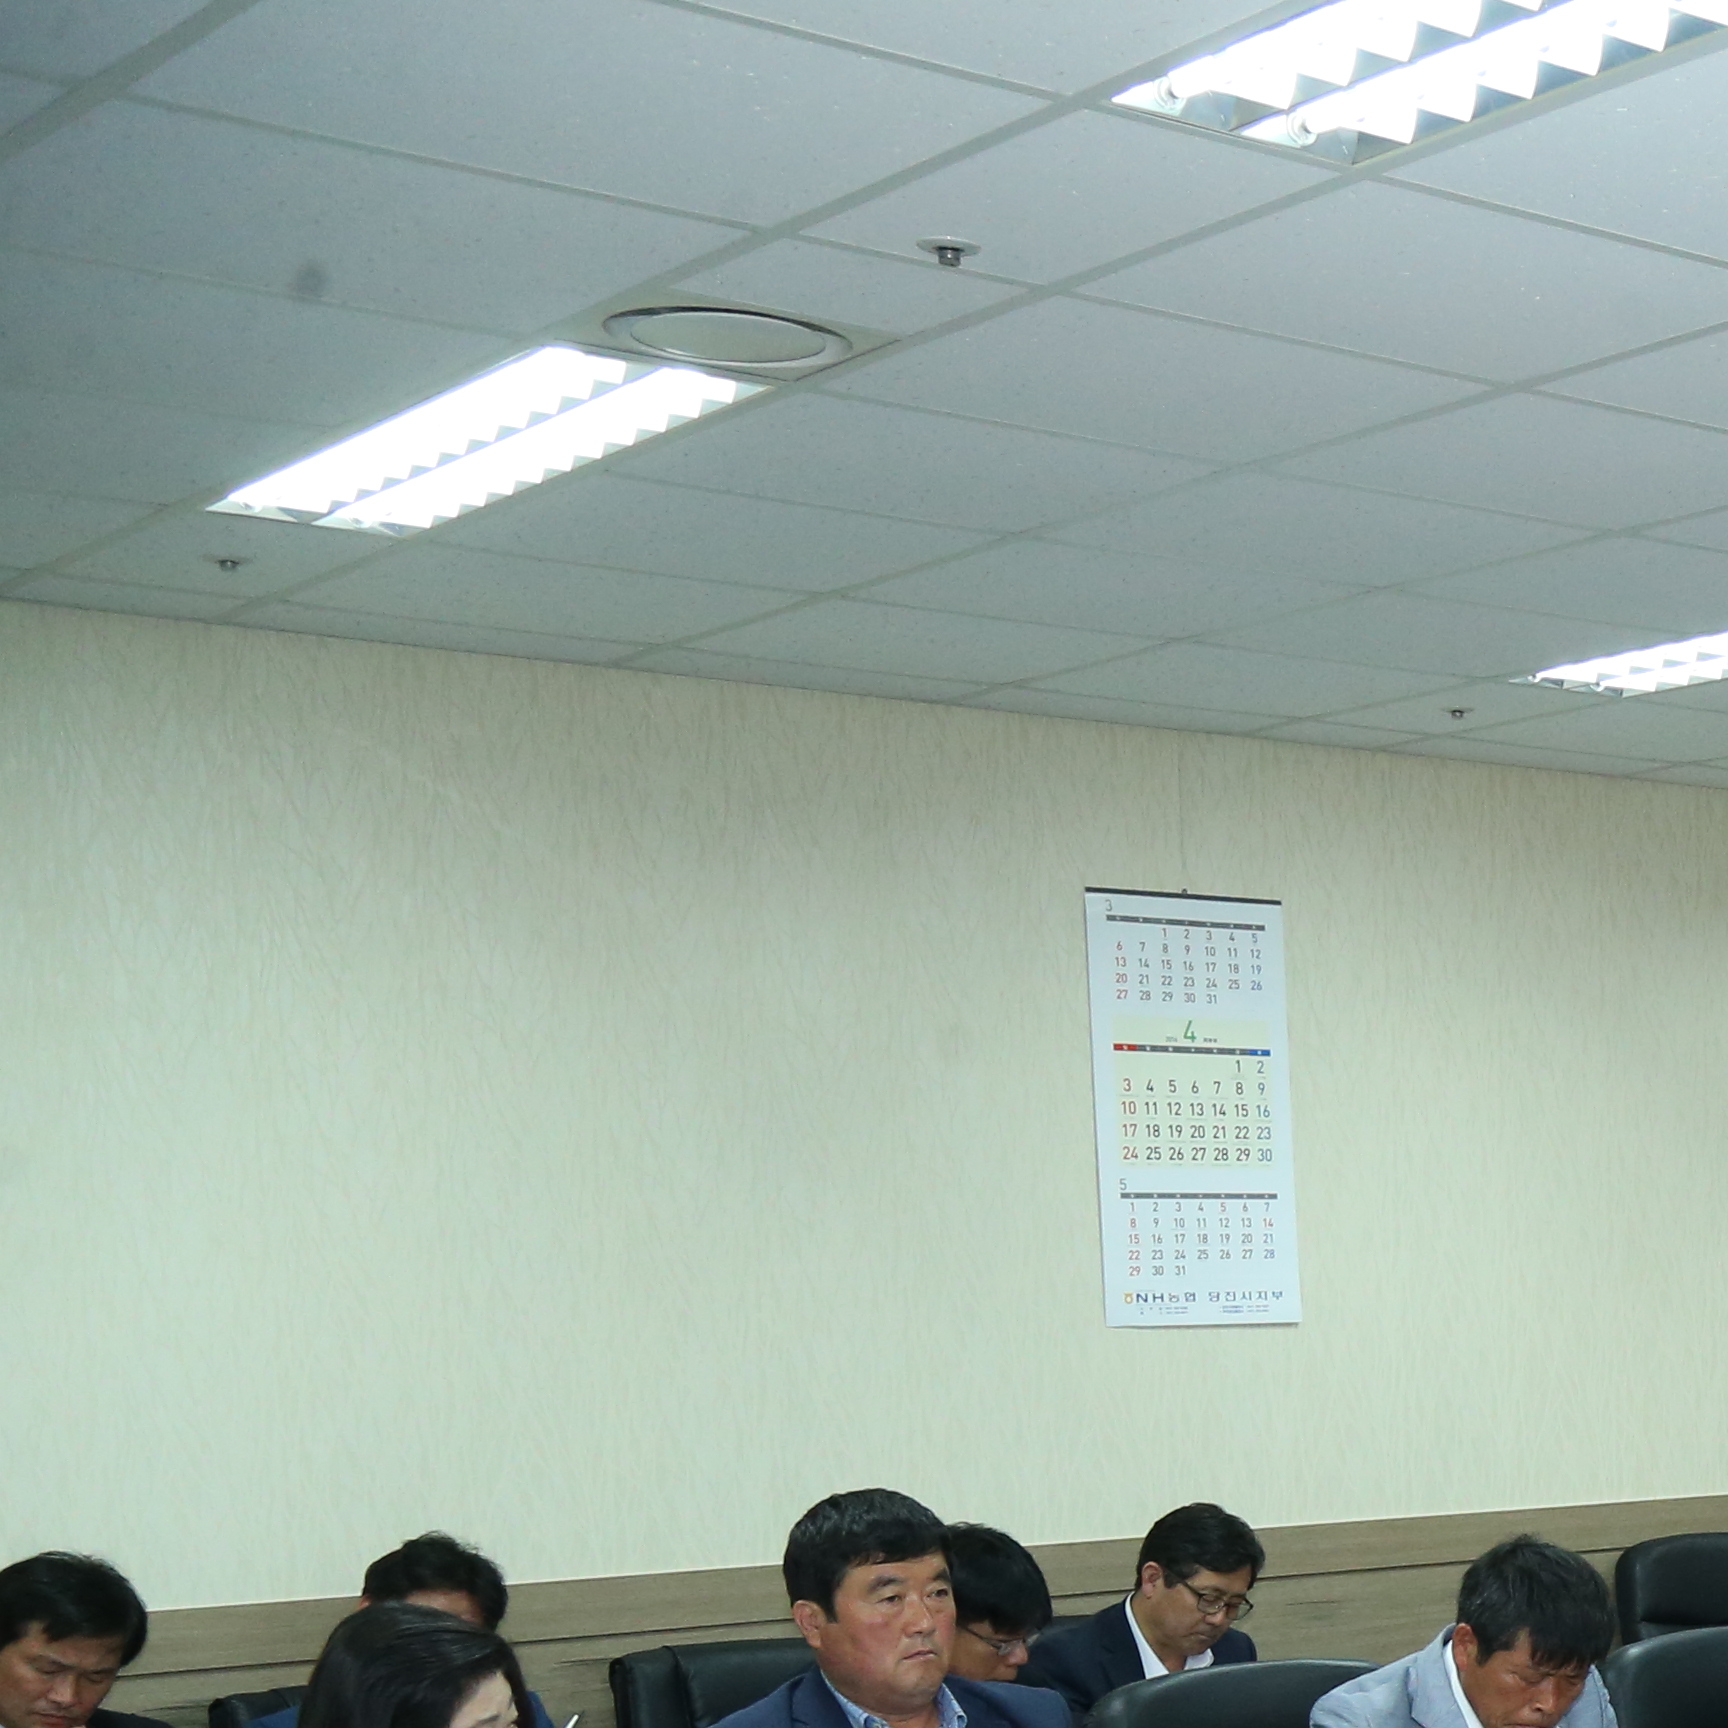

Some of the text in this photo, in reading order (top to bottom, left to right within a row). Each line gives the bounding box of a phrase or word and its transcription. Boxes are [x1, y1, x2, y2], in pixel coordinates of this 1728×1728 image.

[1105, 899, 1112, 912] 3
[1162, 928, 1258, 943] 1 2 3 4 5
[1116, 941, 1261, 959] 6 7 8 9 10 11 12
[1115, 957, 1261, 975] 13 14 15 16 17 18 19
[1116, 973, 1262, 991] 20 21 22 23 24 25 26
[1116, 989, 1217, 1004] 27 28 29 30 31
[1183, 1020, 1197, 1043] 4
[1236, 1060, 1264, 1074] 1 2
[1123, 1078, 1265, 1095] 3 4 5 6 7 8 9
[1121, 1101, 1270, 1118] 10 11 12 13 14 15 16
[1122, 1124, 1271, 1140] 17 18 19 20 21 22 23
[1123, 1146, 1272, 1162] 24 25 26 27 28 29 30
[1120, 1178, 1127, 1191] 5
[1130, 1202, 1270, 1212] 1 2 3 4 5 6 7
[1130, 1217, 1273, 1228] 8 9 10 11 12 13 14
[1129, 1233, 1273, 1245] 15 16 17 18 19 20 21
[1129, 1249, 1275, 1260] 22 23 24 25 26 27 28
[1129, 1265, 1185, 1276] 29 30 31
